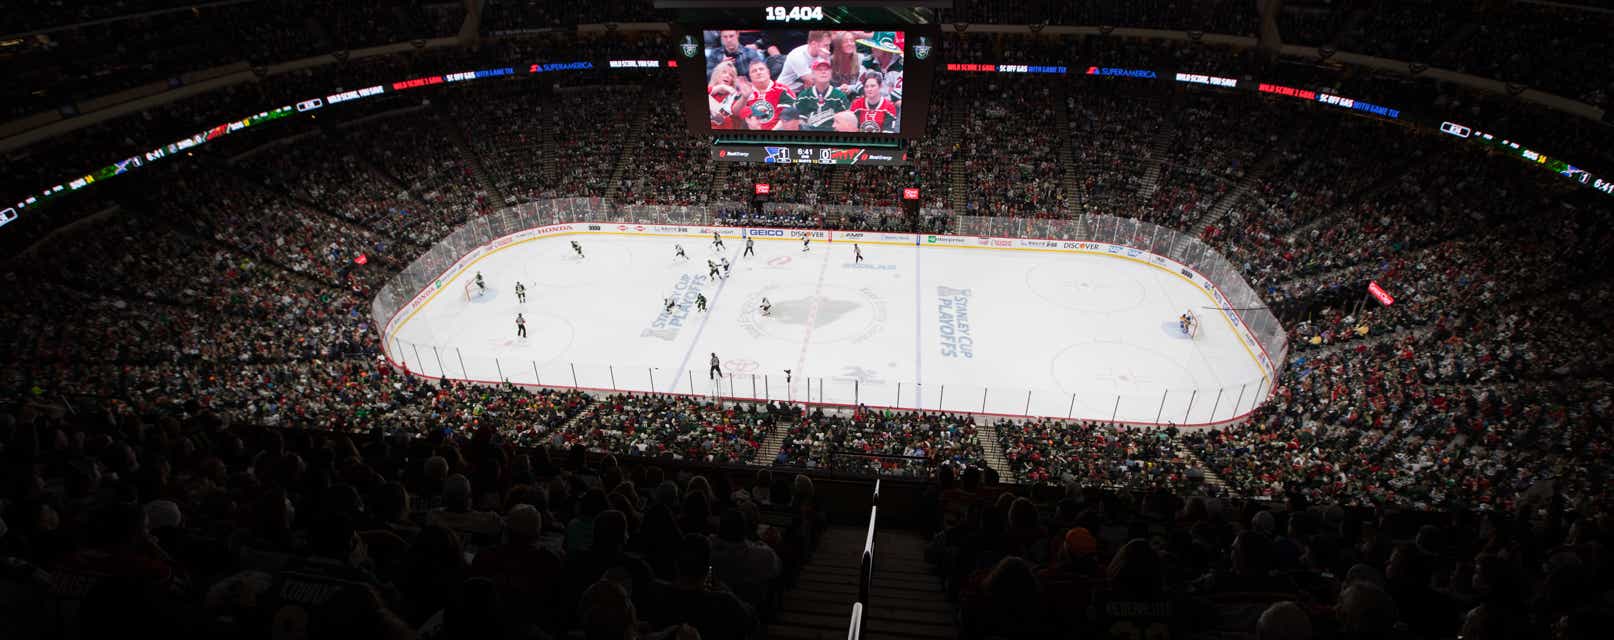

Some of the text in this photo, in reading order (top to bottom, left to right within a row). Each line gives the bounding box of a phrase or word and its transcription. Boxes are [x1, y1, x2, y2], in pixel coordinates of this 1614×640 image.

[766, 6, 824, 22] 19,404
[544, 62, 592, 72] SUPERAMERICA
[1102, 67, 1156, 79] SUPERAMERICA
[822, 149, 830, 160] 0
[1594, 178, 1614, 195] 6:41
[538, 225, 573, 234] HONDA
[412, 287, 436, 308] HONDA
[938, 298, 958, 358] PLAYOFFS
[954, 296, 973, 358] STANLEY CUP
